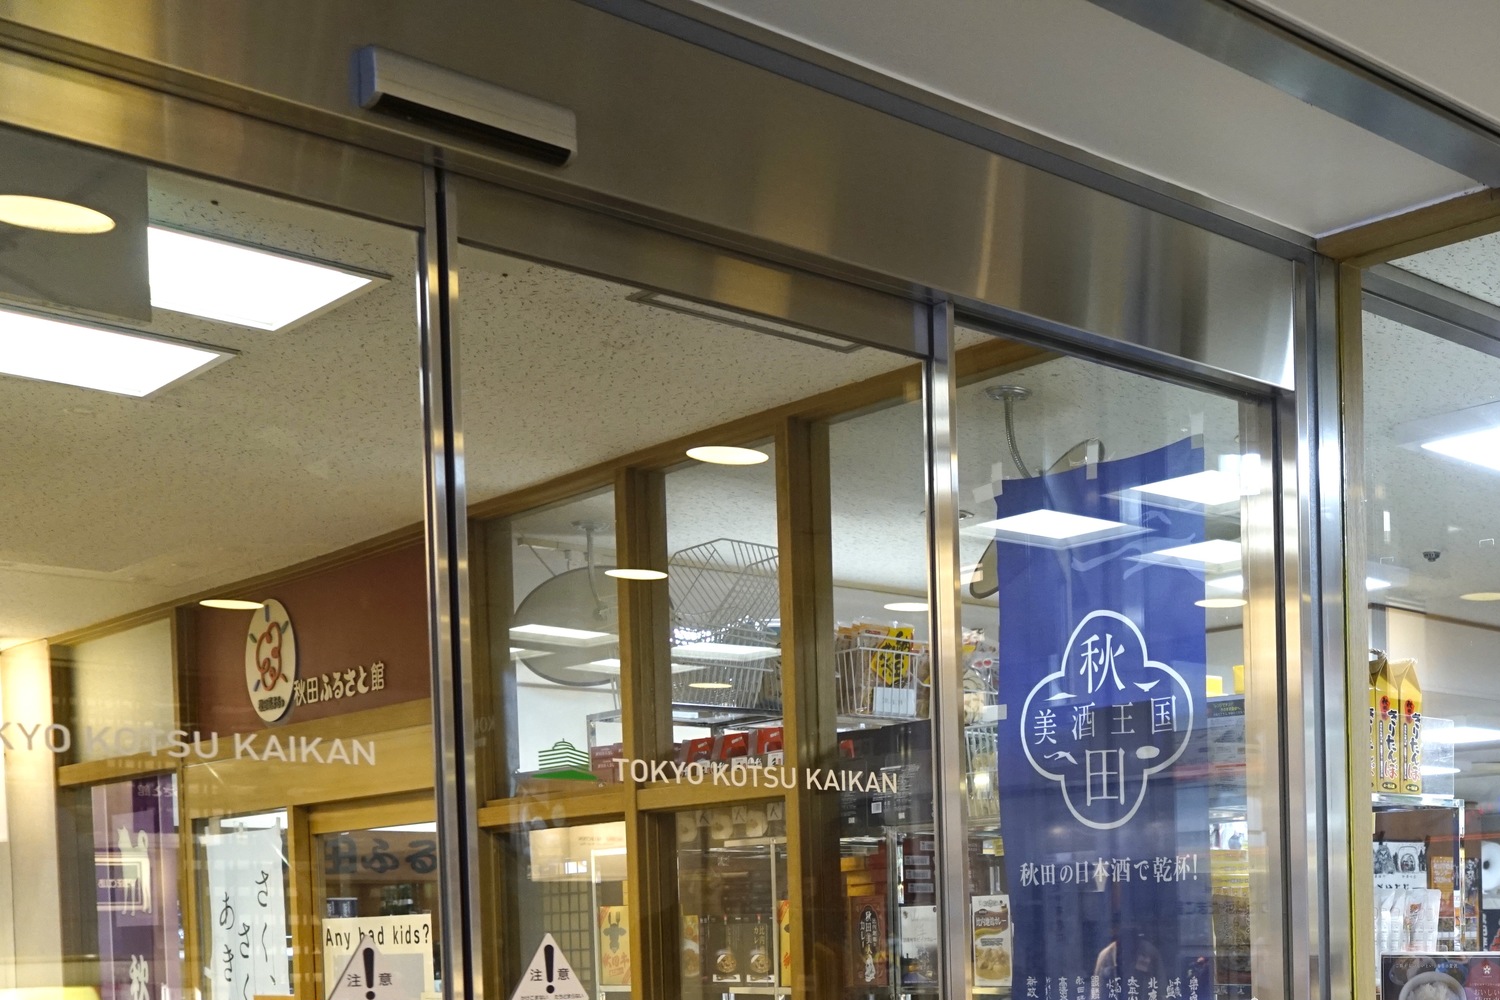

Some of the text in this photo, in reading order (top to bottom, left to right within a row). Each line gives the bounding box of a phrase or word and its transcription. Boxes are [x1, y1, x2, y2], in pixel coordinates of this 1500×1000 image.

[1079, 633, 1126, 694] 秋
[294, 661, 385, 707] 秋田ふるさと館
[1033, 695, 1178, 746] 美酒王国
[85, 726, 376, 766] KOTSU KAIKAN
[612, 757, 898, 793] TOKYO KOTSU KAIKAN
[1085, 747, 1126, 807] 田
[1019, 853, 1199, 888] 秋田の日本酒で乾杯!
[326, 928, 350, 949] Any
[392, 923, 430, 945] kids?
[1474, 988, 1500, 996] おいしい
